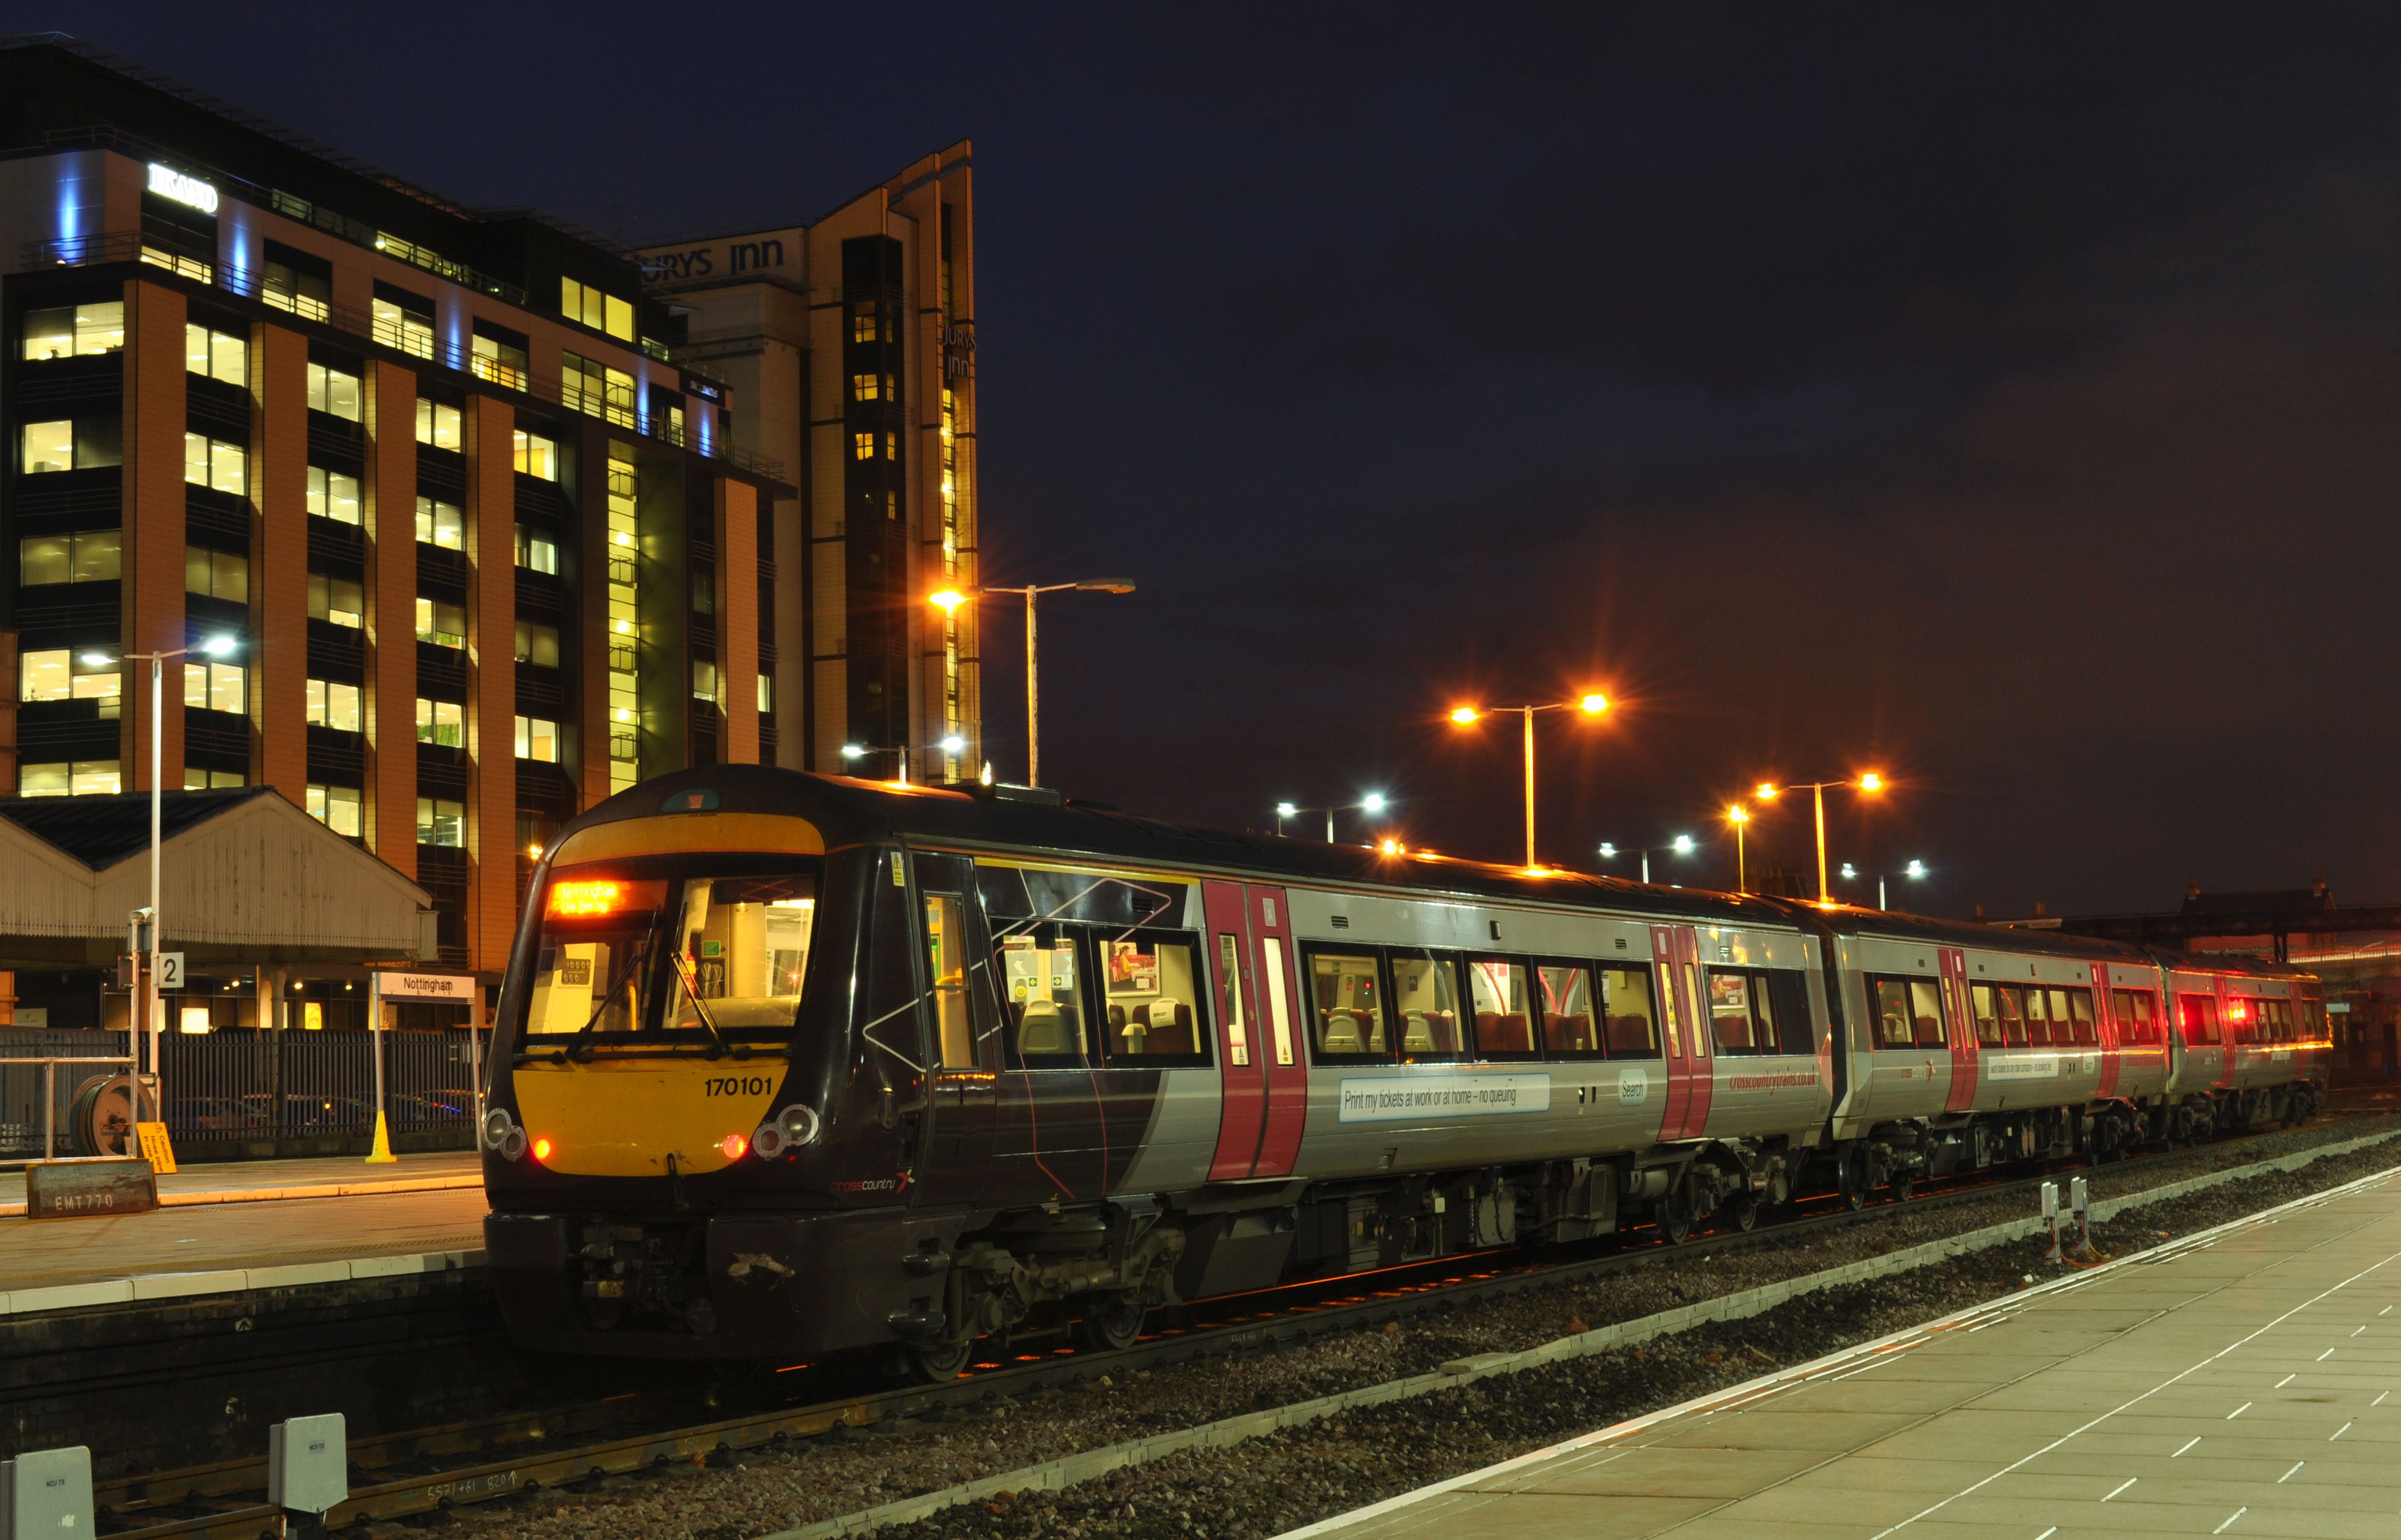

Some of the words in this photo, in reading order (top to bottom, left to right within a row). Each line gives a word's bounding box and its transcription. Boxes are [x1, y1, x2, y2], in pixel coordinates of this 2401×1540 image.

[639, 248, 713, 283] URYS
[943, 323, 976, 351] JURYS
[947, 355, 969, 380] Inn
[164, 958, 176, 982] 2
[404, 977, 453, 993] Nottingham
[705, 1077, 772, 1097] 170101
[1622, 1080, 1643, 1097] Search
[1730, 1066, 1816, 1096] crosscountrytrains.co.uk
[1345, 1090, 1364, 1109] Print
[1365, 1095, 1378, 1113] my
[1380, 1089, 1404, 1108] tickets
[1405, 1089, 1413, 1106] at
[1414, 1087, 1432, 1106] work
[1433, 1092, 1442, 1105] or
[1443, 1088, 1451, 1105] at
[1452, 1087, 1472, 1104] home
[1480, 1090, 1488, 1103] no
[1490, 1084, 1516, 1107] queuing
[159, 1135, 170, 1164] Caution
[155, 1157, 163, 1172] pipe
[830, 1178, 896, 1192] crosscountry
[487, 1475, 506, 1490] 820
